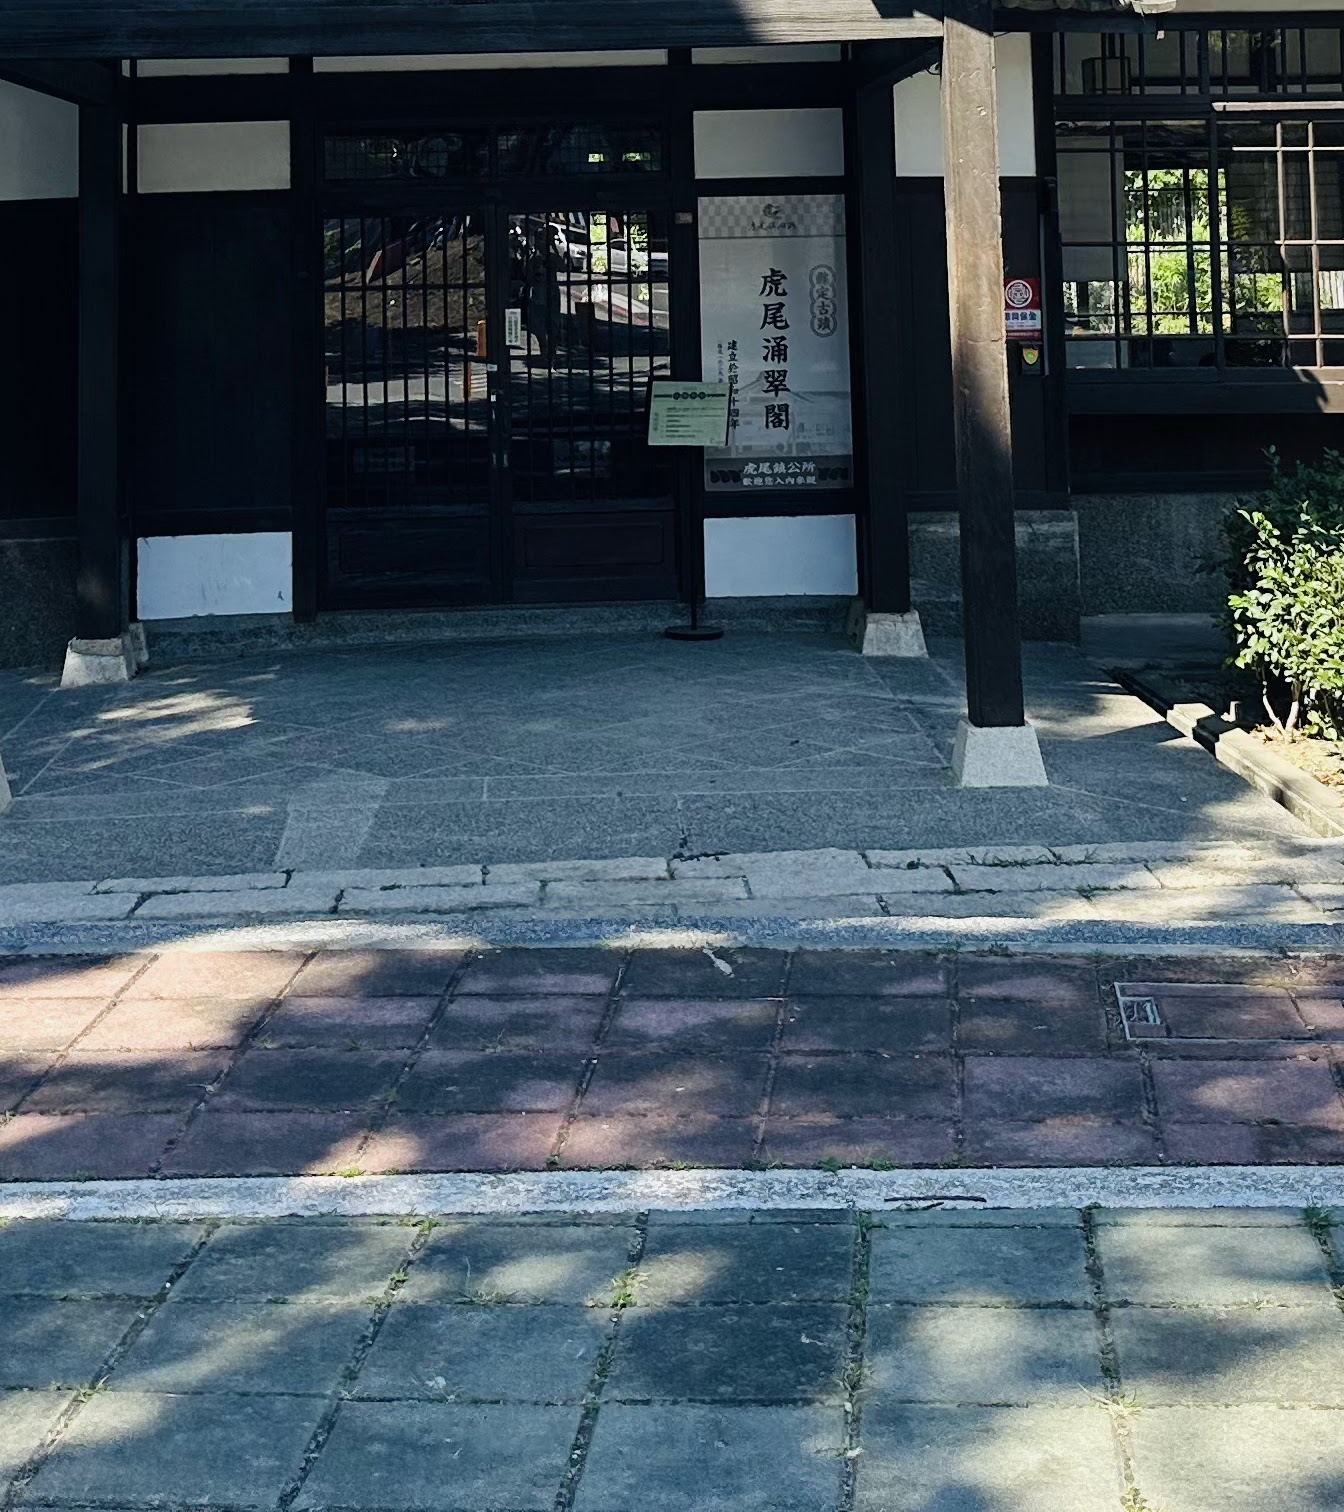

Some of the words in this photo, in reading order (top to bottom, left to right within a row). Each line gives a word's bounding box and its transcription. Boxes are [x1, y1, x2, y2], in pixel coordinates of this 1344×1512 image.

[759, 268, 791, 431] 虎尾涌翠閣
[743, 461, 816, 475] 虎尾鎮公所
